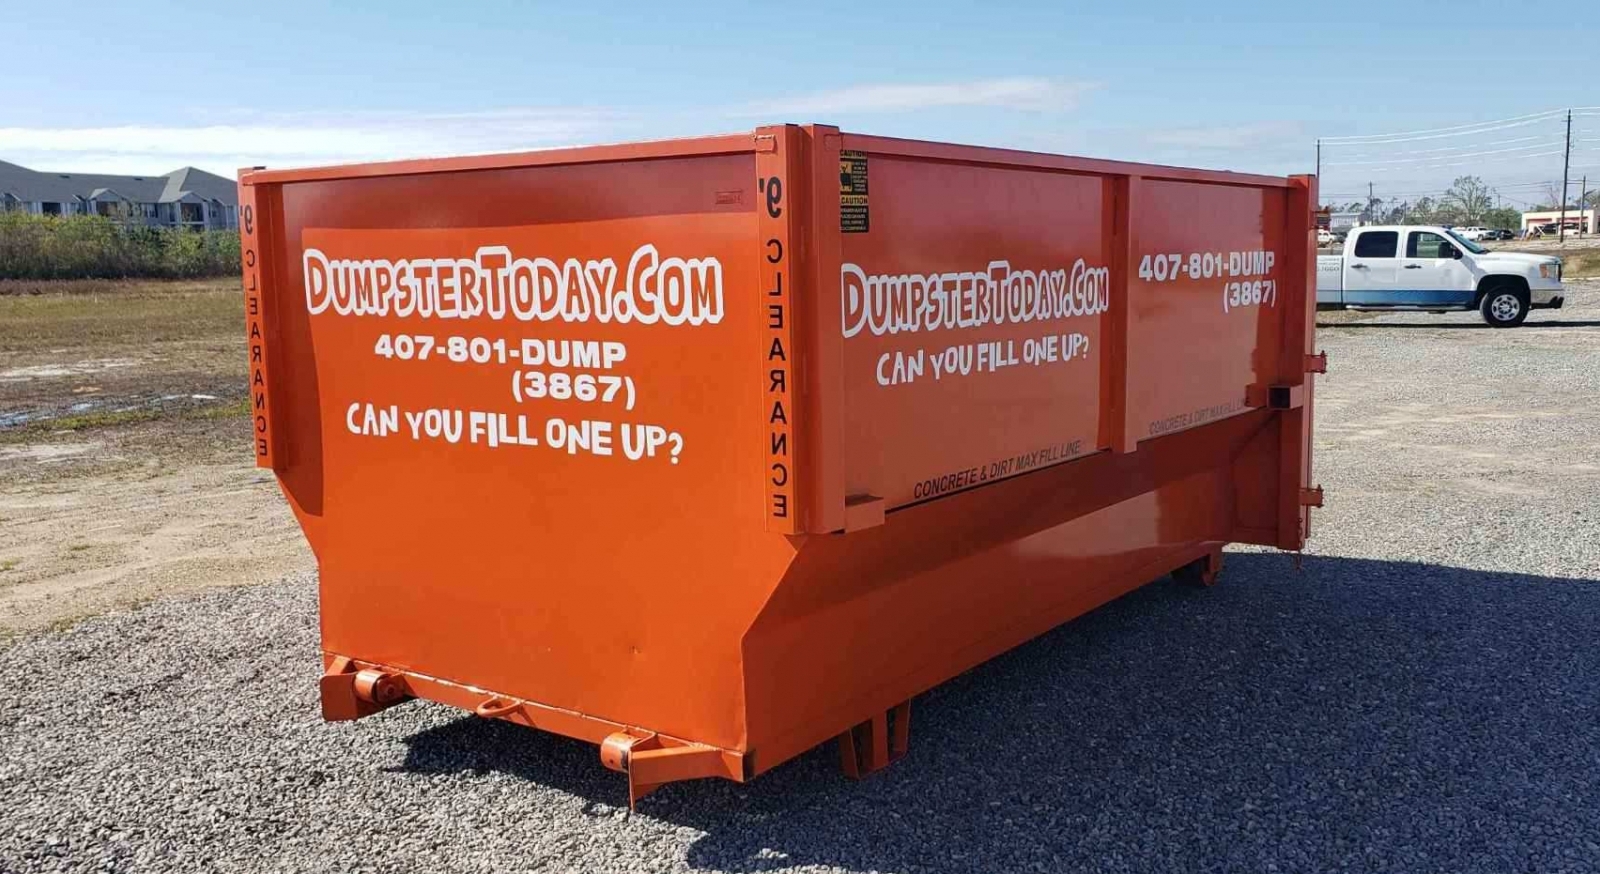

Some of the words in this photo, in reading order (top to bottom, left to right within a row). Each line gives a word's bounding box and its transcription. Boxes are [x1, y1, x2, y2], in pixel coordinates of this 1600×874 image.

[841, 196, 868, 205] CAUTION
[1138, 250, 1275, 282] 407-801-DUMP
[1223, 280, 1276, 314] (3867)
[375, 335, 627, 369] 407-801-DUMP
[876, 350, 924, 386] CAN
[930, 345, 973, 380] YOU
[977, 341, 1019, 372] FILL
[1023, 335, 1058, 366] ONE
[1061, 333, 1089, 362] UP?
[512, 371, 636, 410] (3867)
[346, 403, 399, 437] CAN
[405, 409, 463, 444] YOU
[469, 412, 539, 448] FILL
[545, 418, 613, 456] ONE
[620, 424, 684, 466] UP?
[1149, 413, 1188, 436] CONCRETE
[914, 467, 979, 499] CONCRETE
[980, 465, 987, 481] &
[990, 457, 1014, 478] DIRT
[1015, 450, 1039, 470] MAX
[1038, 446, 1059, 465] FILL
[1060, 439, 1082, 459] LINE
